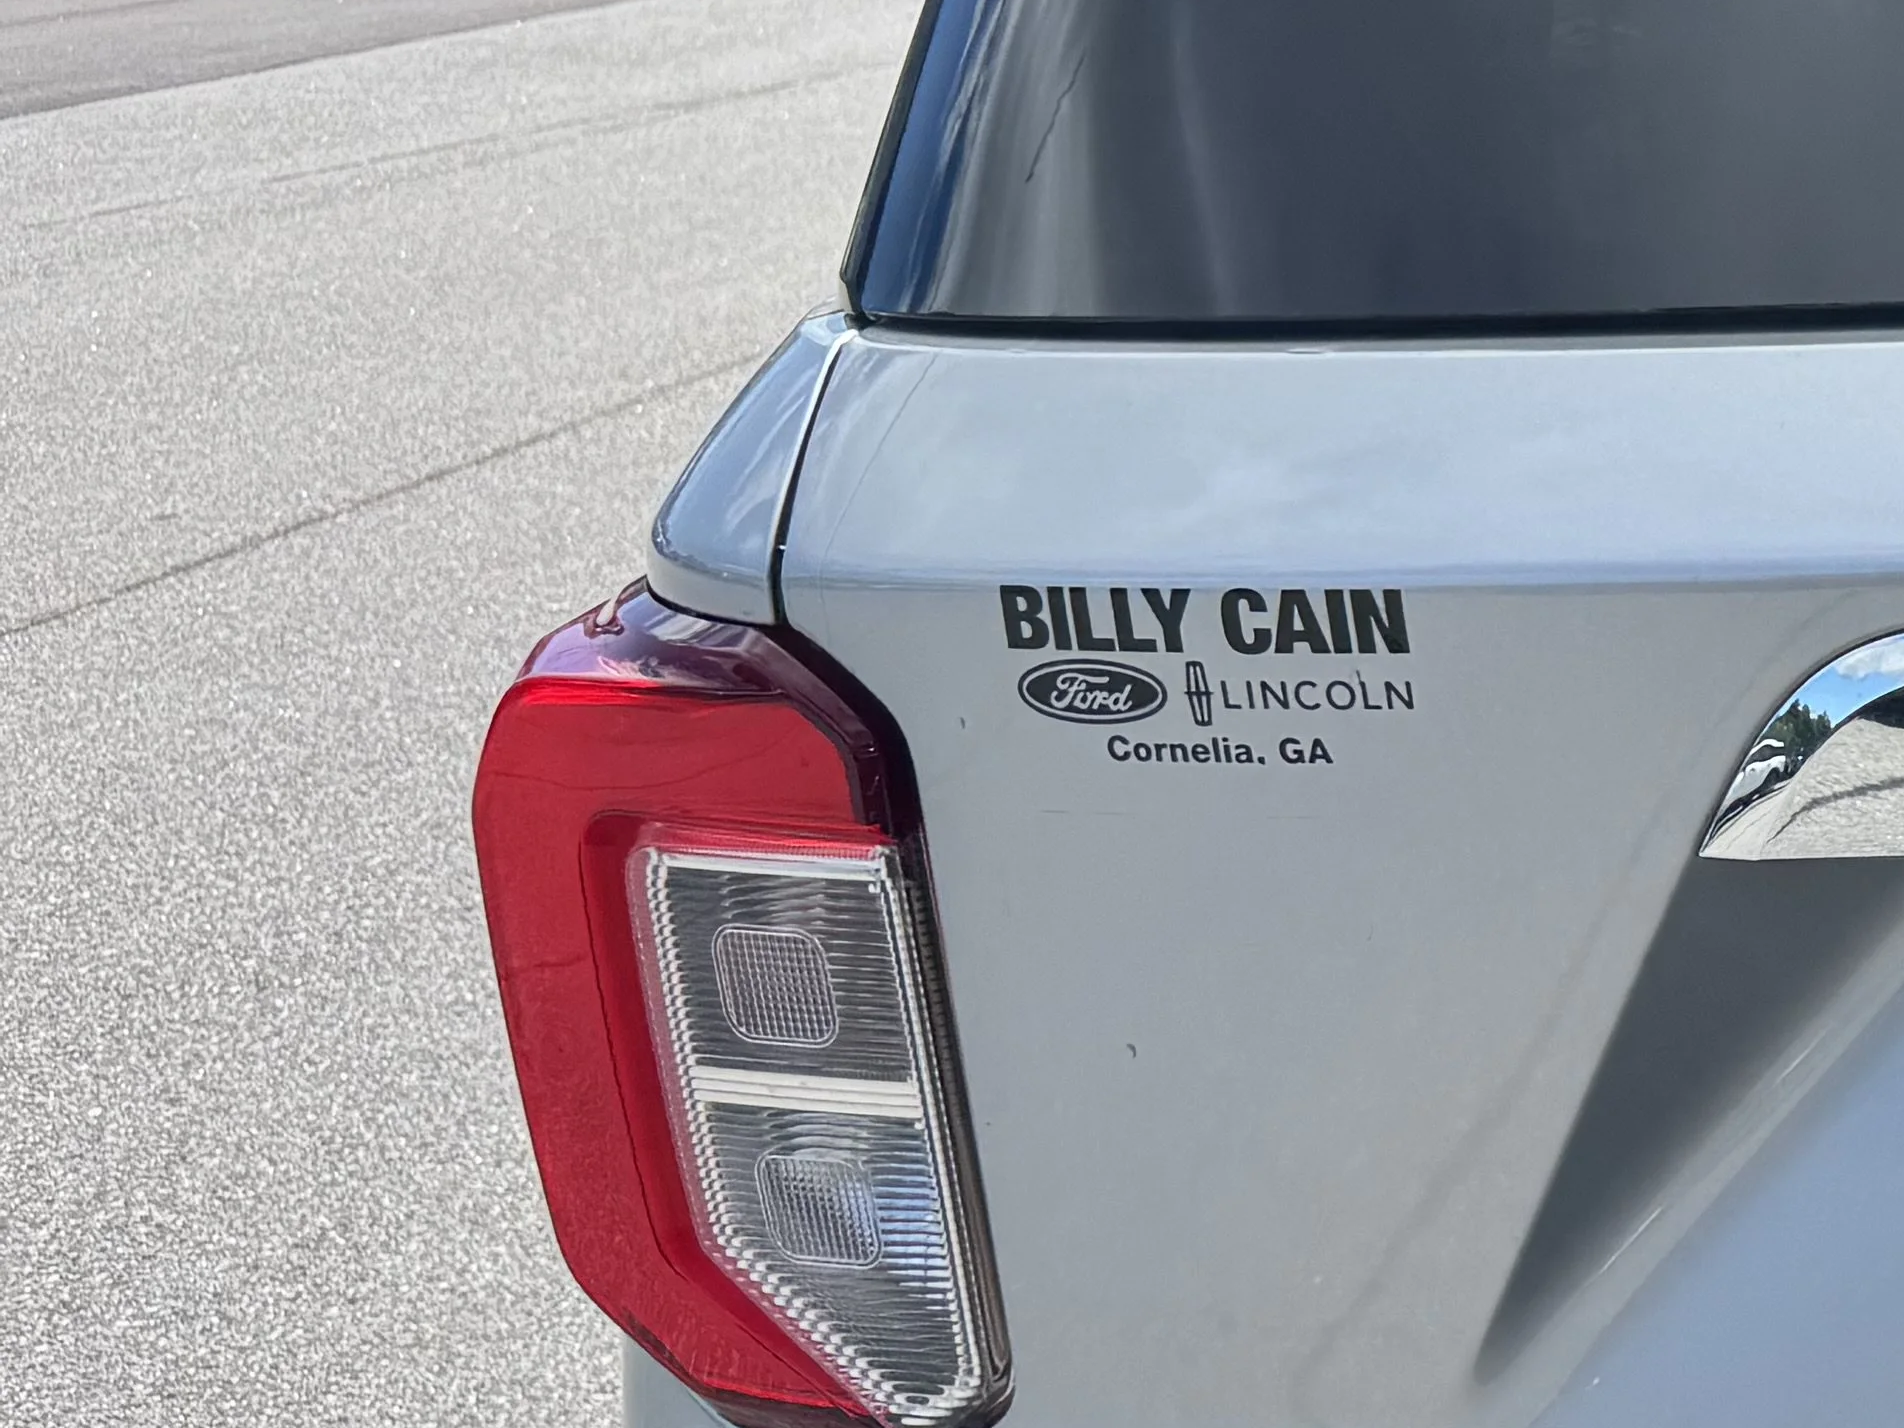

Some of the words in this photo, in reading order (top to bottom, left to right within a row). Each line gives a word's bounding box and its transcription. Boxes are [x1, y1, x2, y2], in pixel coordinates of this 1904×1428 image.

[999, 584, 1192, 654] BILLY
[1220, 587, 1411, 656] CAIN
[1049, 671, 1133, 713] Ford
[1219, 678, 1415, 711] LINCOLN
[1106, 734, 1266, 766] Cornelia,
[1278, 736, 1335, 766] GA
